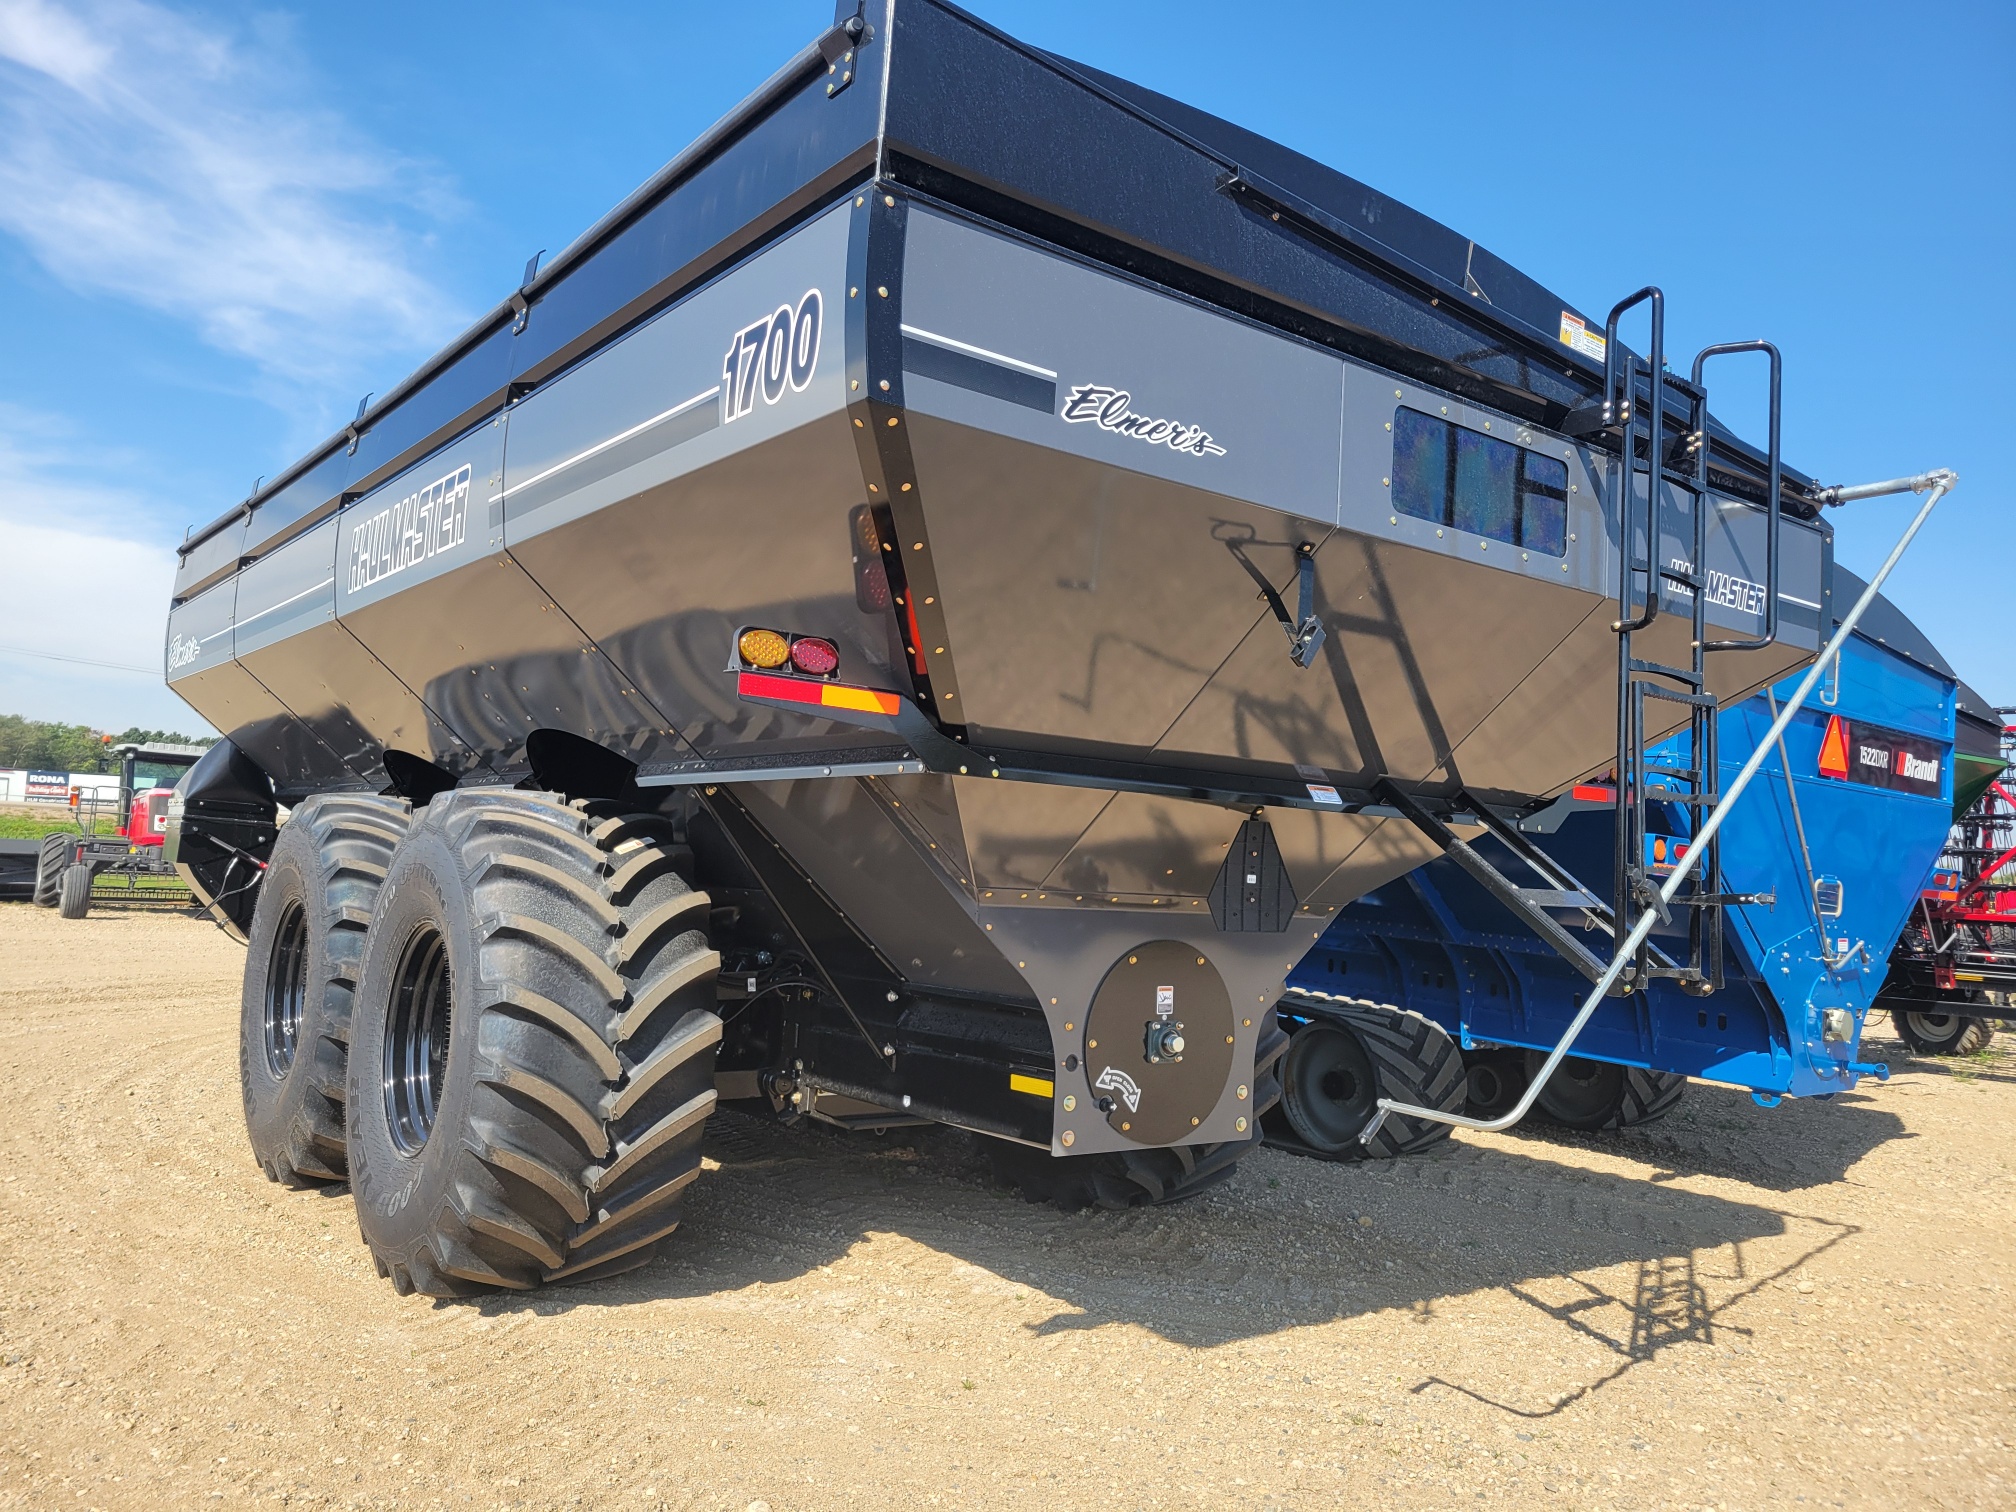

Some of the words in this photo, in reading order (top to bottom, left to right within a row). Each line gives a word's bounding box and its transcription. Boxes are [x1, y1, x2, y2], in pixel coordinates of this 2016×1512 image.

[723, 288, 823, 425] 1700
[1061, 383, 1227, 457] Elmer's
[348, 463, 472, 594] HAULMASTER
[1668, 559, 1766, 616] HAMASTER
[30, 775, 65, 783] RONA
[1903, 752, 1939, 783] Brandt
